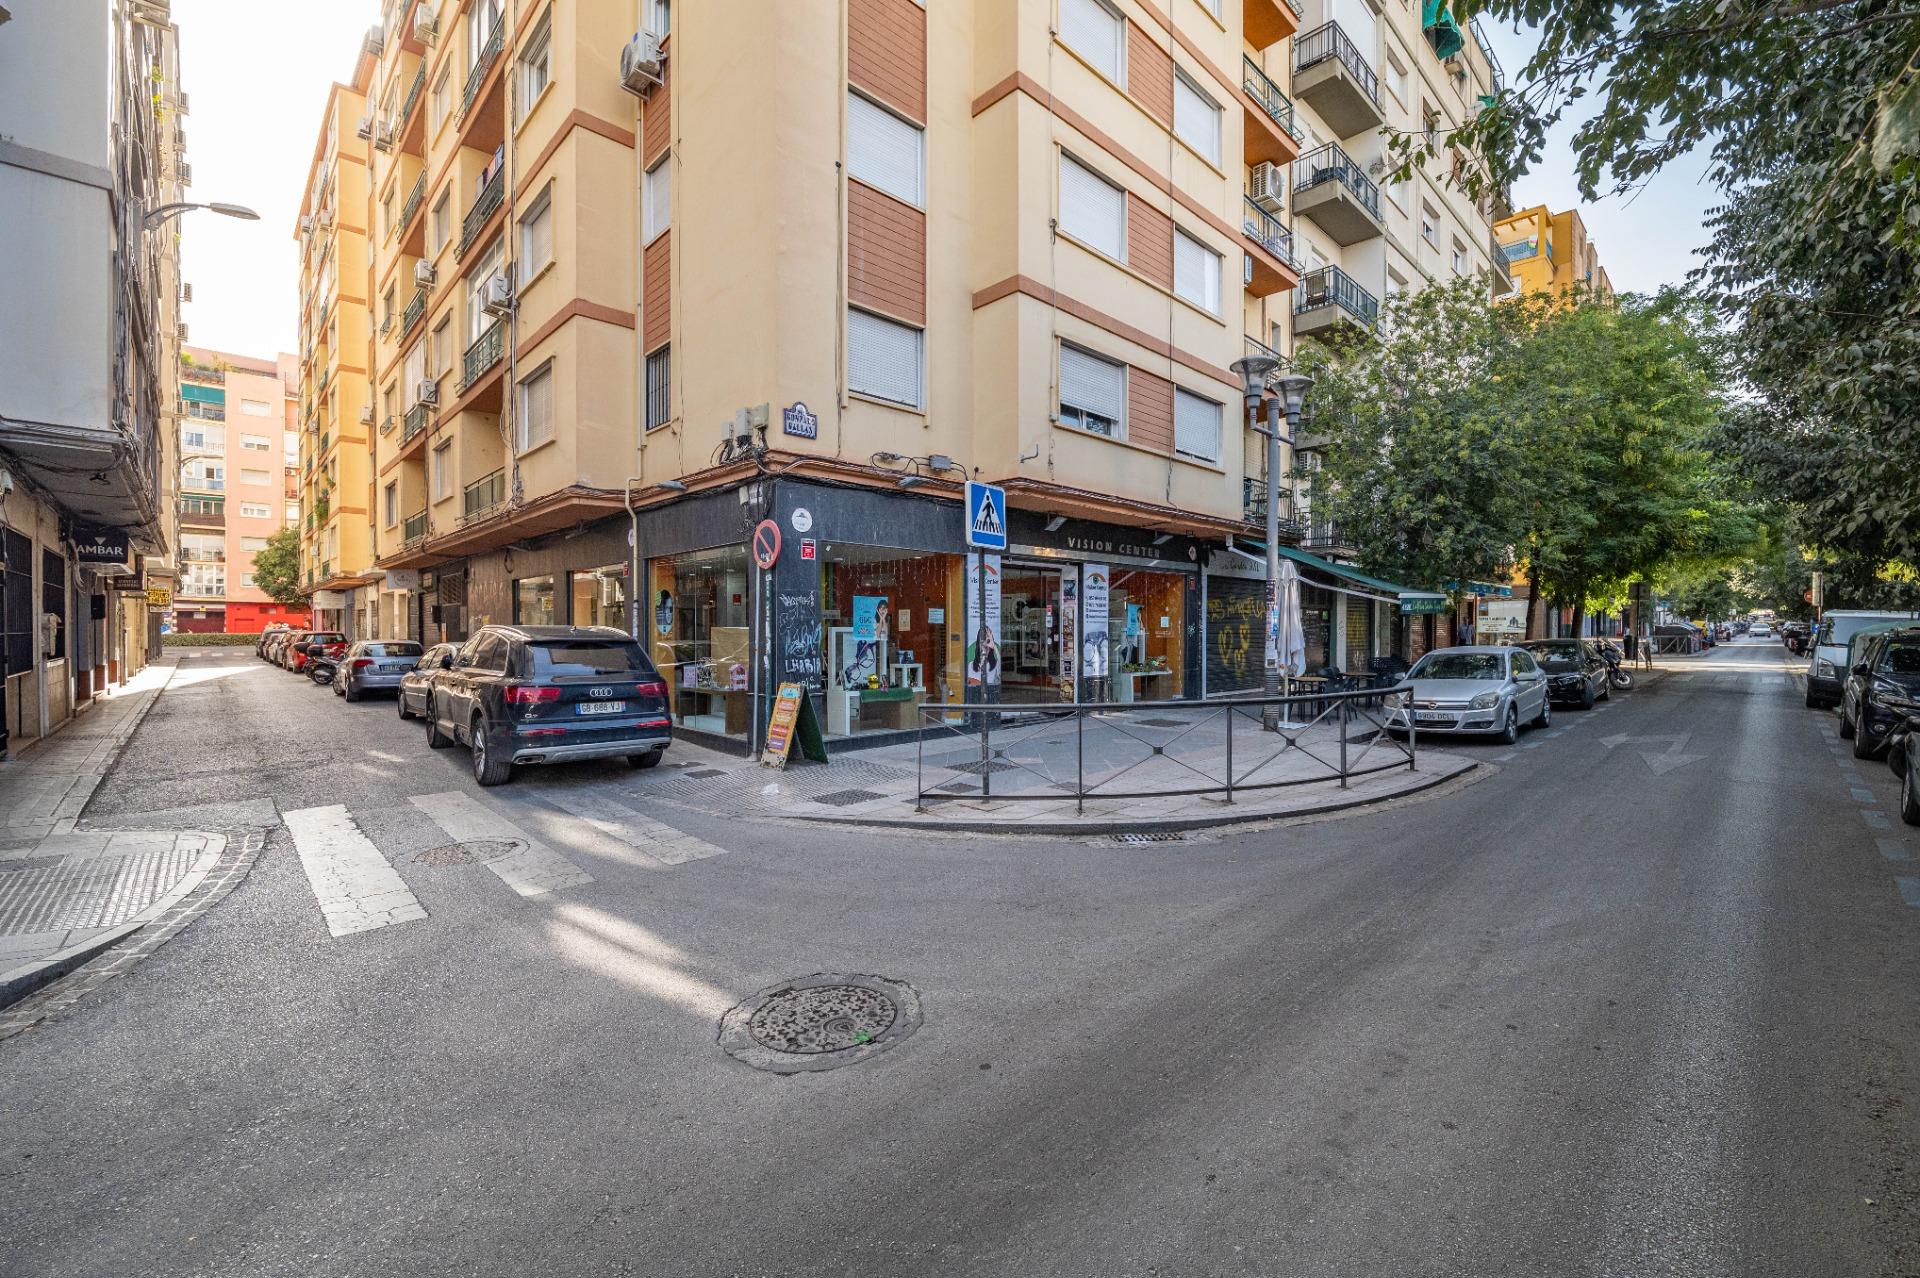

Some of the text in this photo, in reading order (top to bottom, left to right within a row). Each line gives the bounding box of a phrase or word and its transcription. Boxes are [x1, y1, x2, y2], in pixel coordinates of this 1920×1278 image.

[77, 545, 123, 555] AMBAR
[1067, 537, 1161, 559] VISION CENTER
